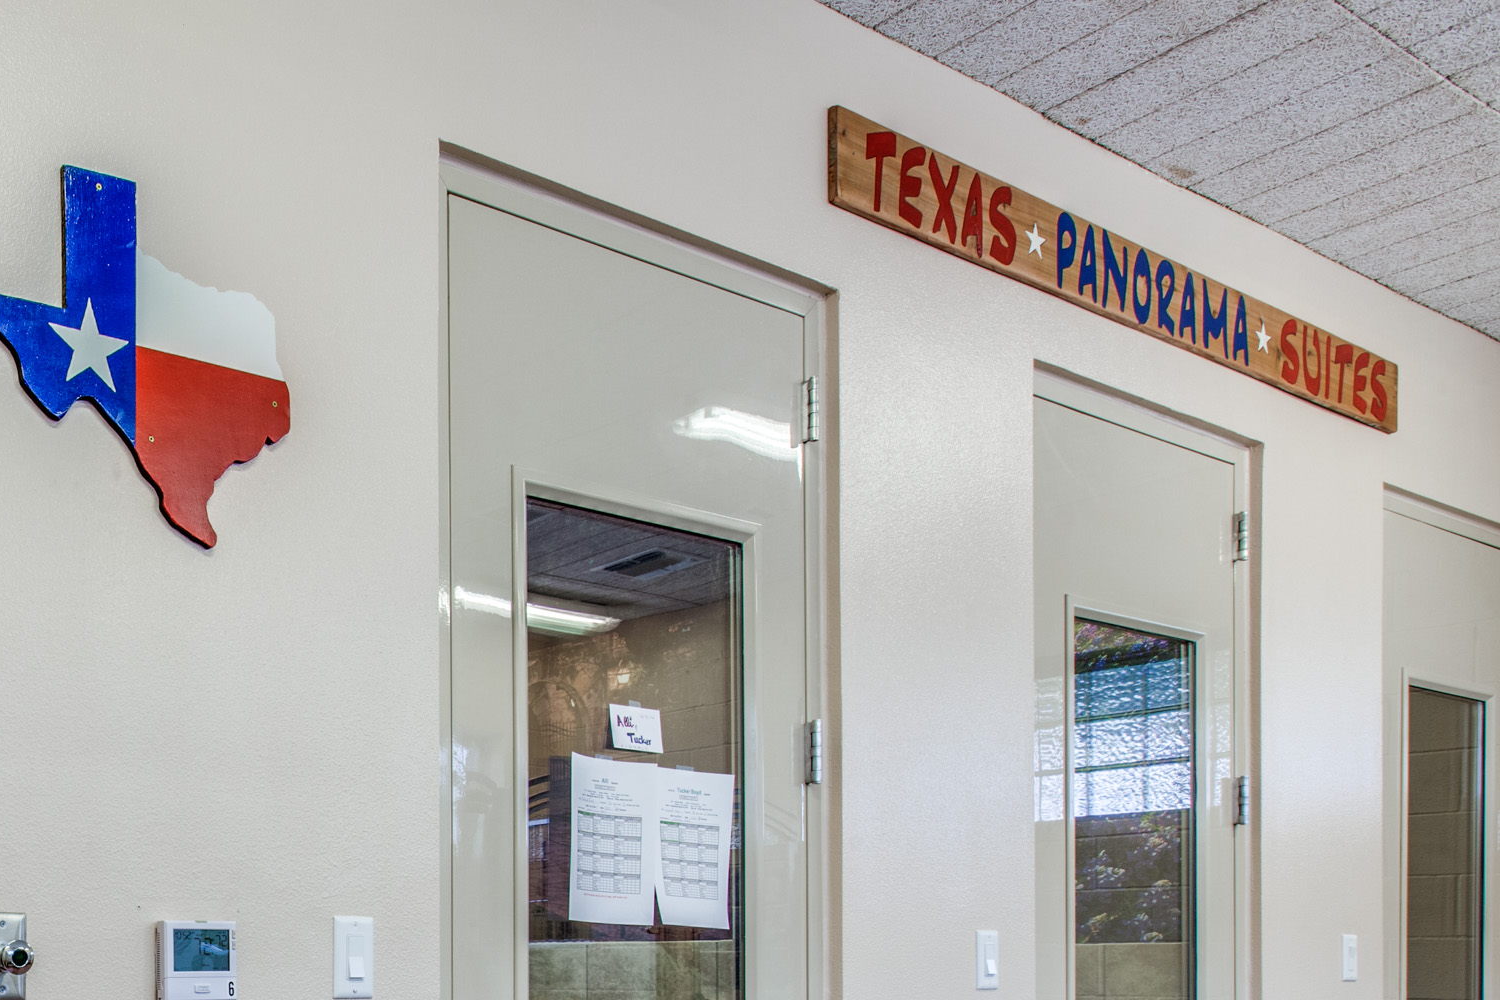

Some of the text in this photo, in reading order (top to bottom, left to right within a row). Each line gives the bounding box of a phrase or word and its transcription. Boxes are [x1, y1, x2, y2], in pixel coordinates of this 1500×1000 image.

[865, 131, 1387, 423] TEXAS PANORAMA SUITES
[626, 732, 652, 746] Tucker
[228, 981, 235, 997] 6
